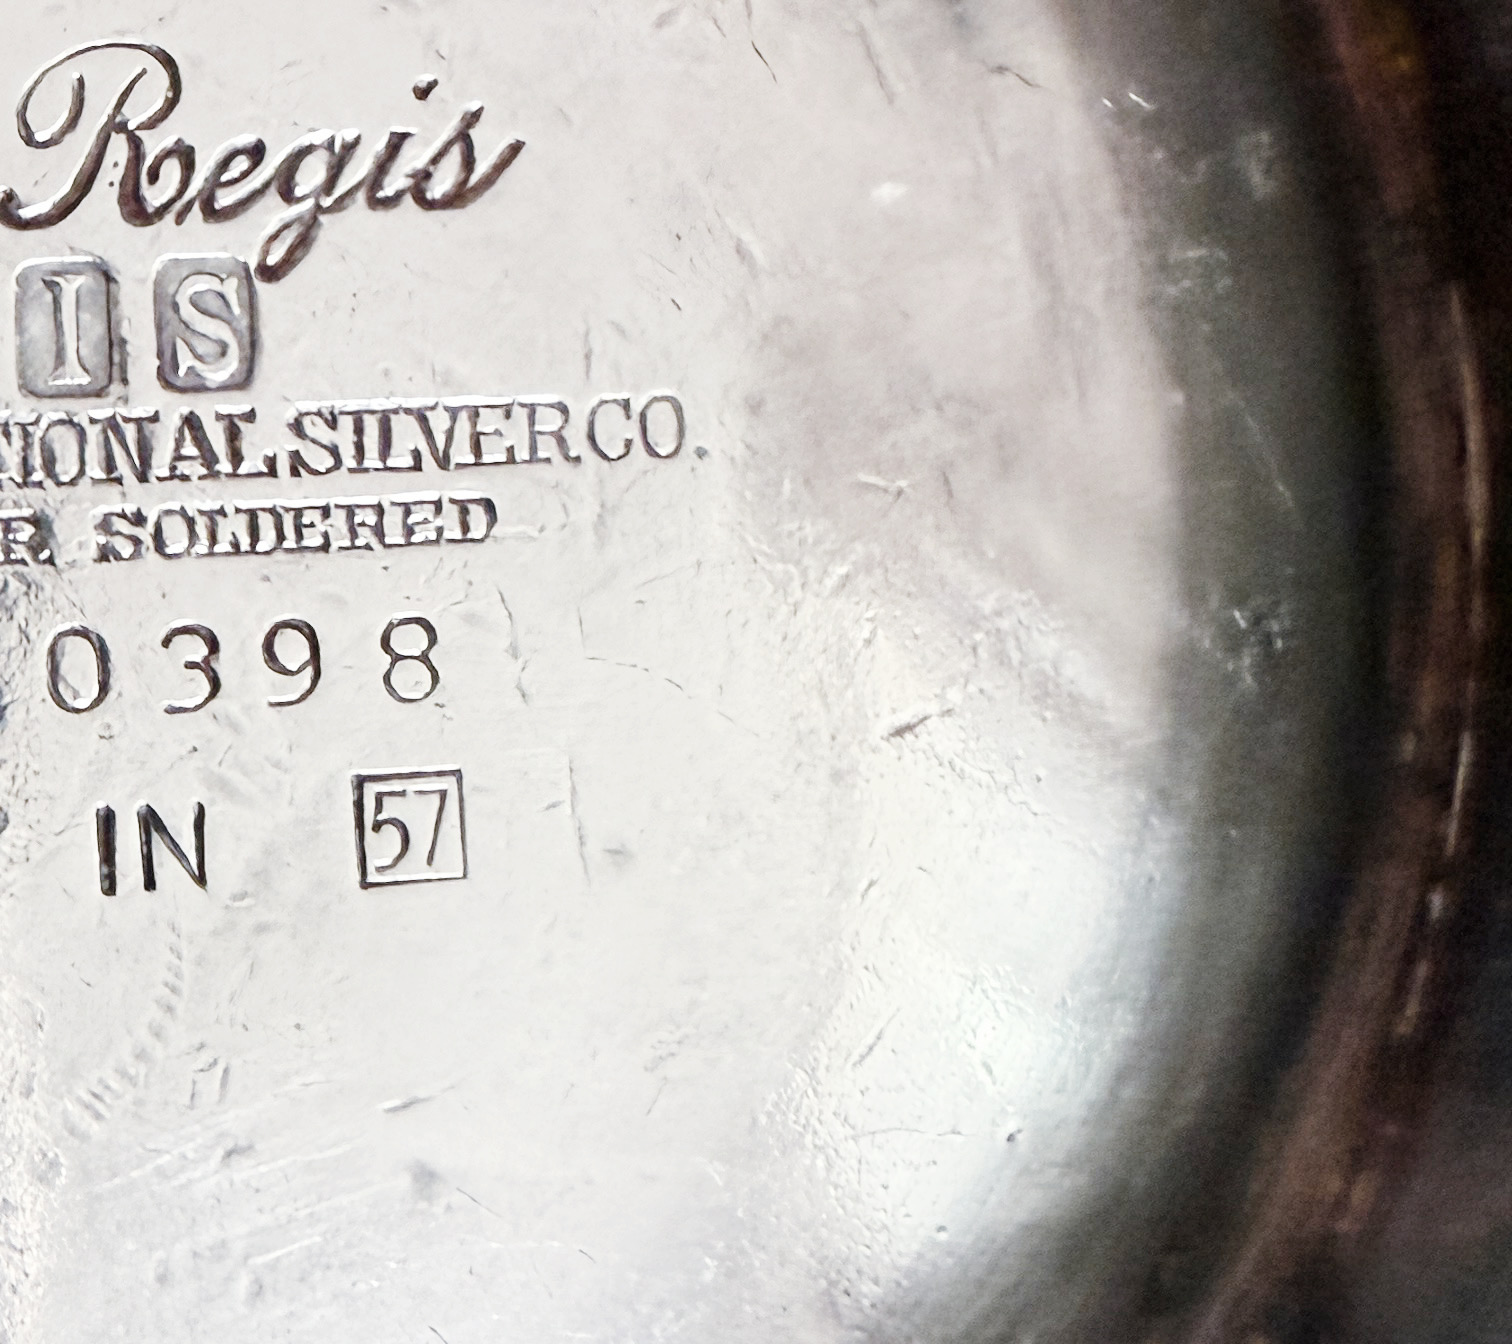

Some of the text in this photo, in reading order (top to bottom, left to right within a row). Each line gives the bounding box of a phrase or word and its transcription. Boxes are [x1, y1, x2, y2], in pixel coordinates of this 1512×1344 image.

[284, 395, 582, 478] SILVER
[586, 392, 710, 464] CO.
[90, 489, 498, 565] SOLDERED
[92, 797, 211, 899] IN
[367, 782, 453, 880] 57
